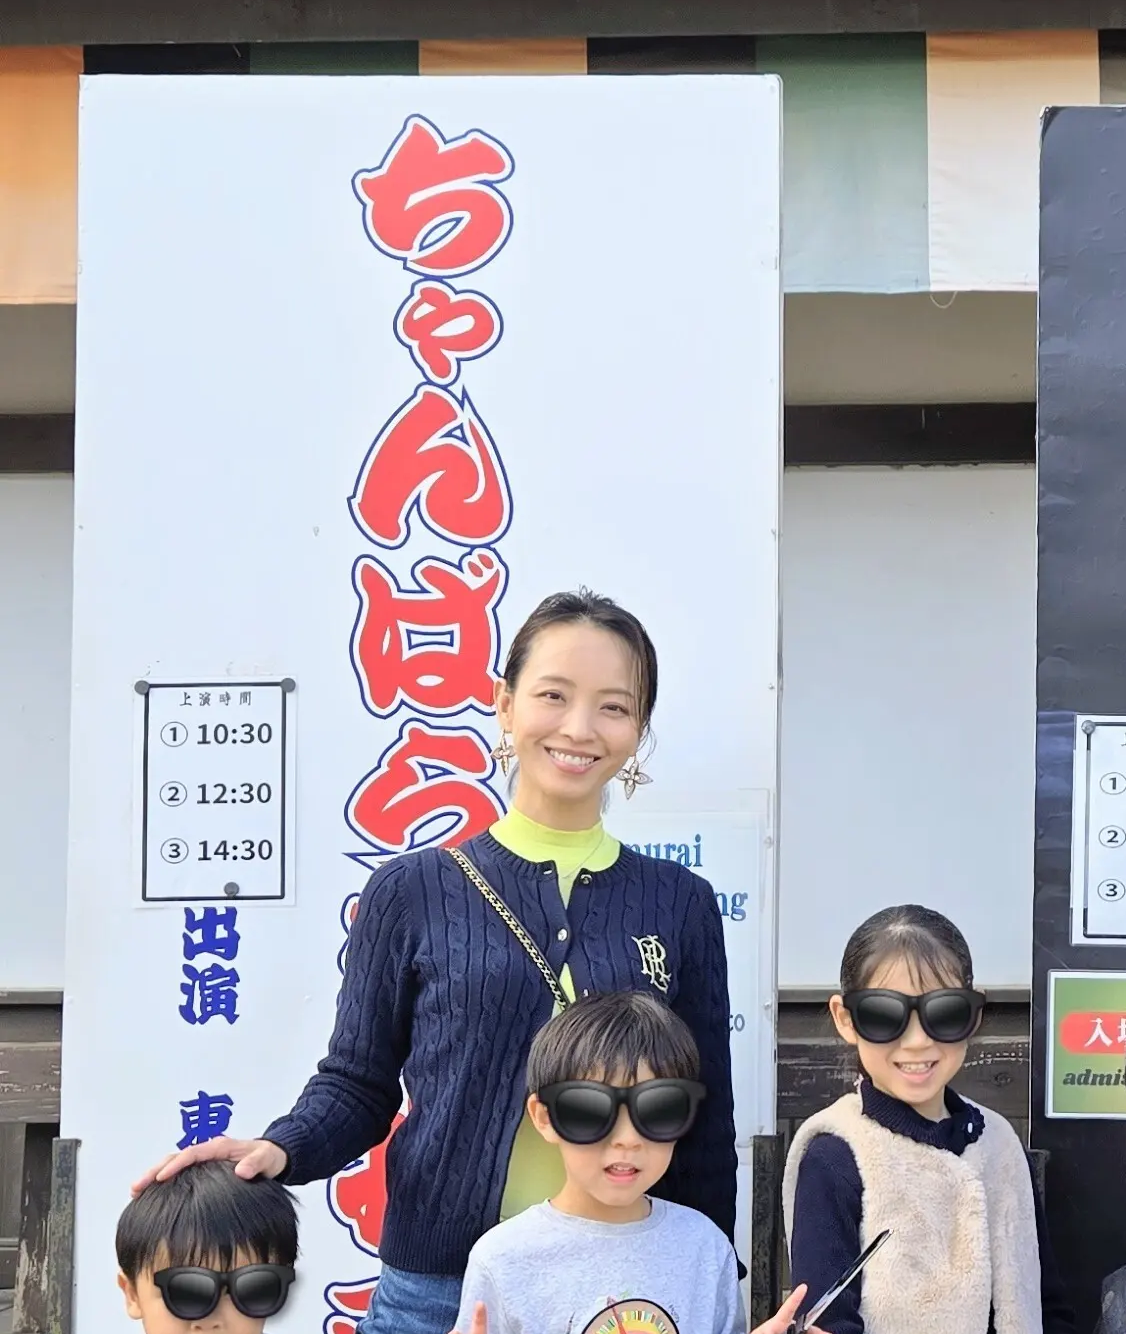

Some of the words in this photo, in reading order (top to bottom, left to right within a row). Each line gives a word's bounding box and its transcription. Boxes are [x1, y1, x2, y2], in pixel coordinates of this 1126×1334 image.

[180, 691, 252, 707] 上演時間
[197, 723, 272, 744] 10:30
[197, 783, 272, 804] 12:30
[198, 840, 273, 861] 14:30
[179, 907, 240, 1025] 出演
